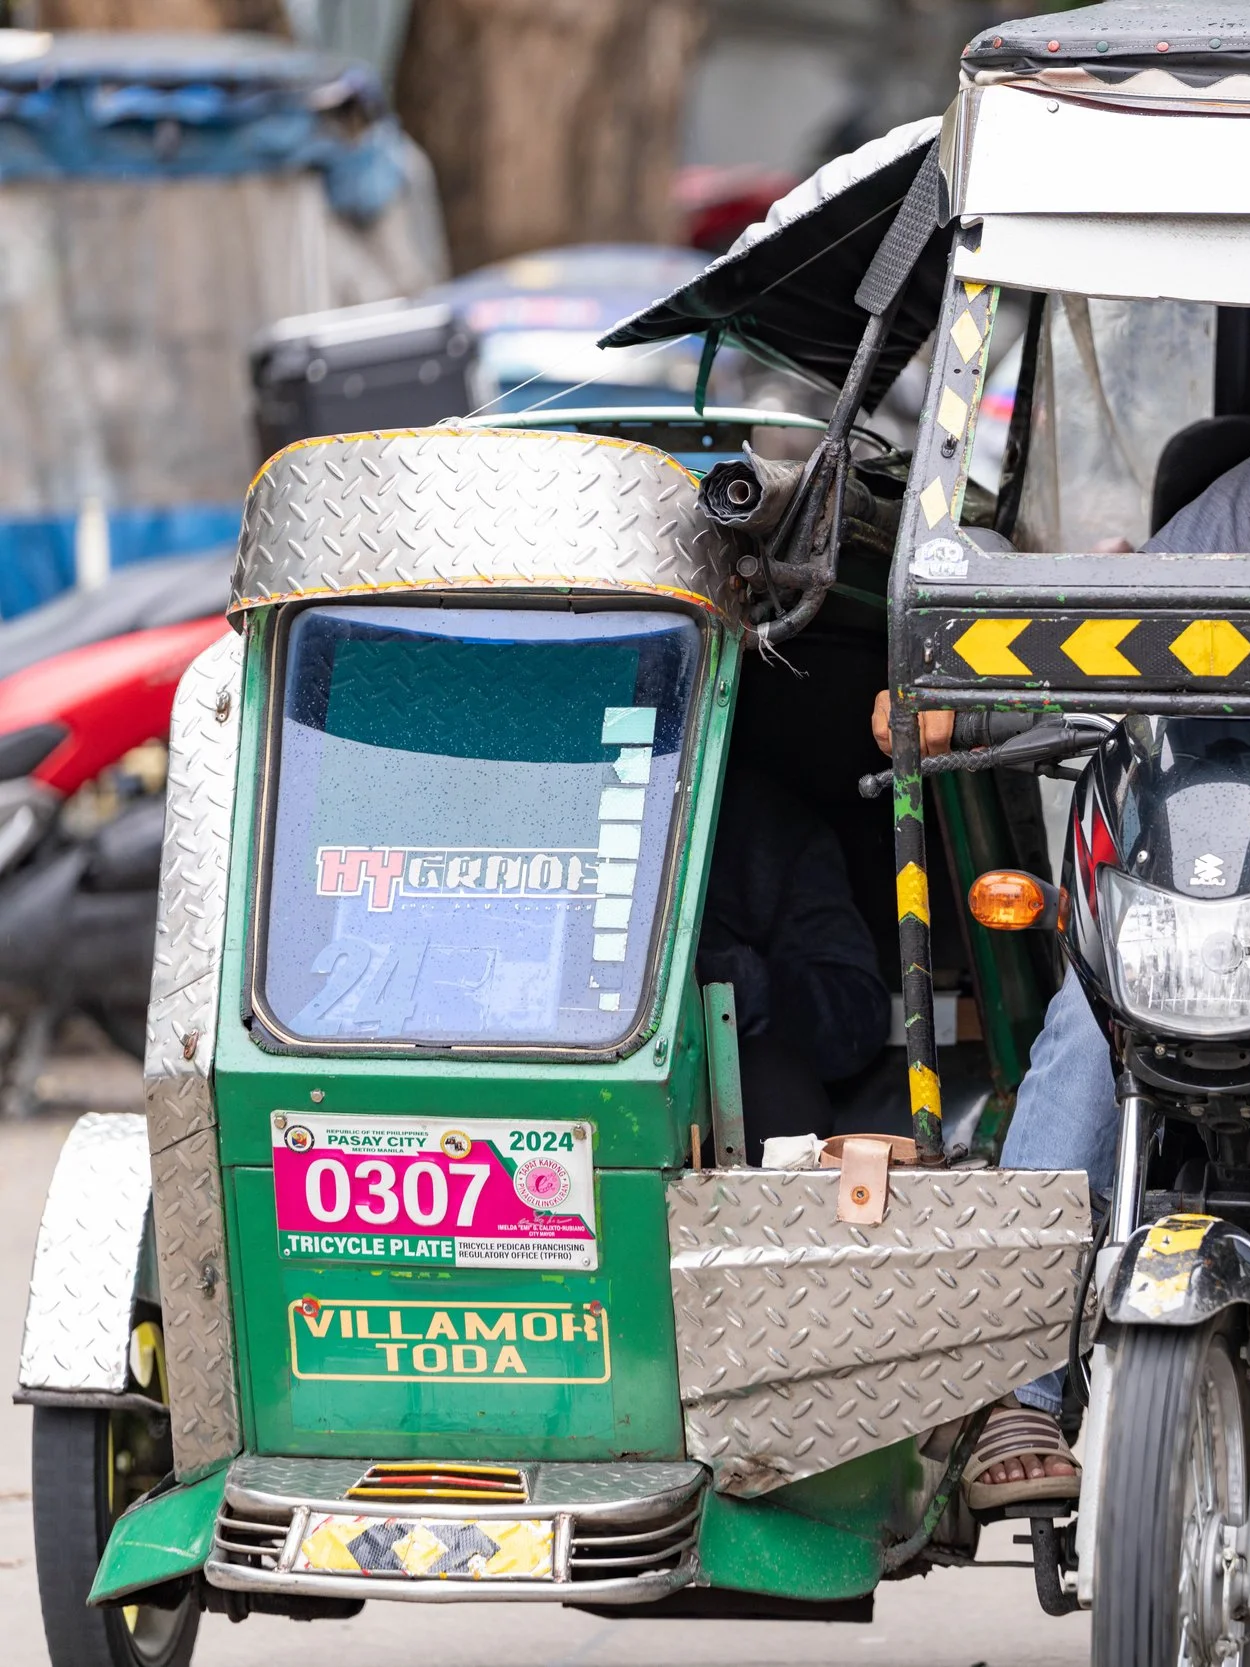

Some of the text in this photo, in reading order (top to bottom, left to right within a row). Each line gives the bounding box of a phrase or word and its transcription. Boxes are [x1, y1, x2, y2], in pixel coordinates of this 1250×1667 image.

[327, 1135, 427, 1147] PASAY CITY
[509, 1130, 574, 1152] 2024
[519, 1159, 567, 1178] TAPAT KAYONG
[304, 1158, 491, 1227] 0307
[287, 1234, 452, 1258] TRICYCLE PLATE
[458, 1242, 585, 1251] TRICYCLE PEDICAB FRANCHISING
[511, 1251, 539, 1259] OFFICE
[540, 1252, 572, 1260] (TPFRO)
[303, 1308, 598, 1341] VILLAMOR
[375, 1343, 528, 1373] TODA
